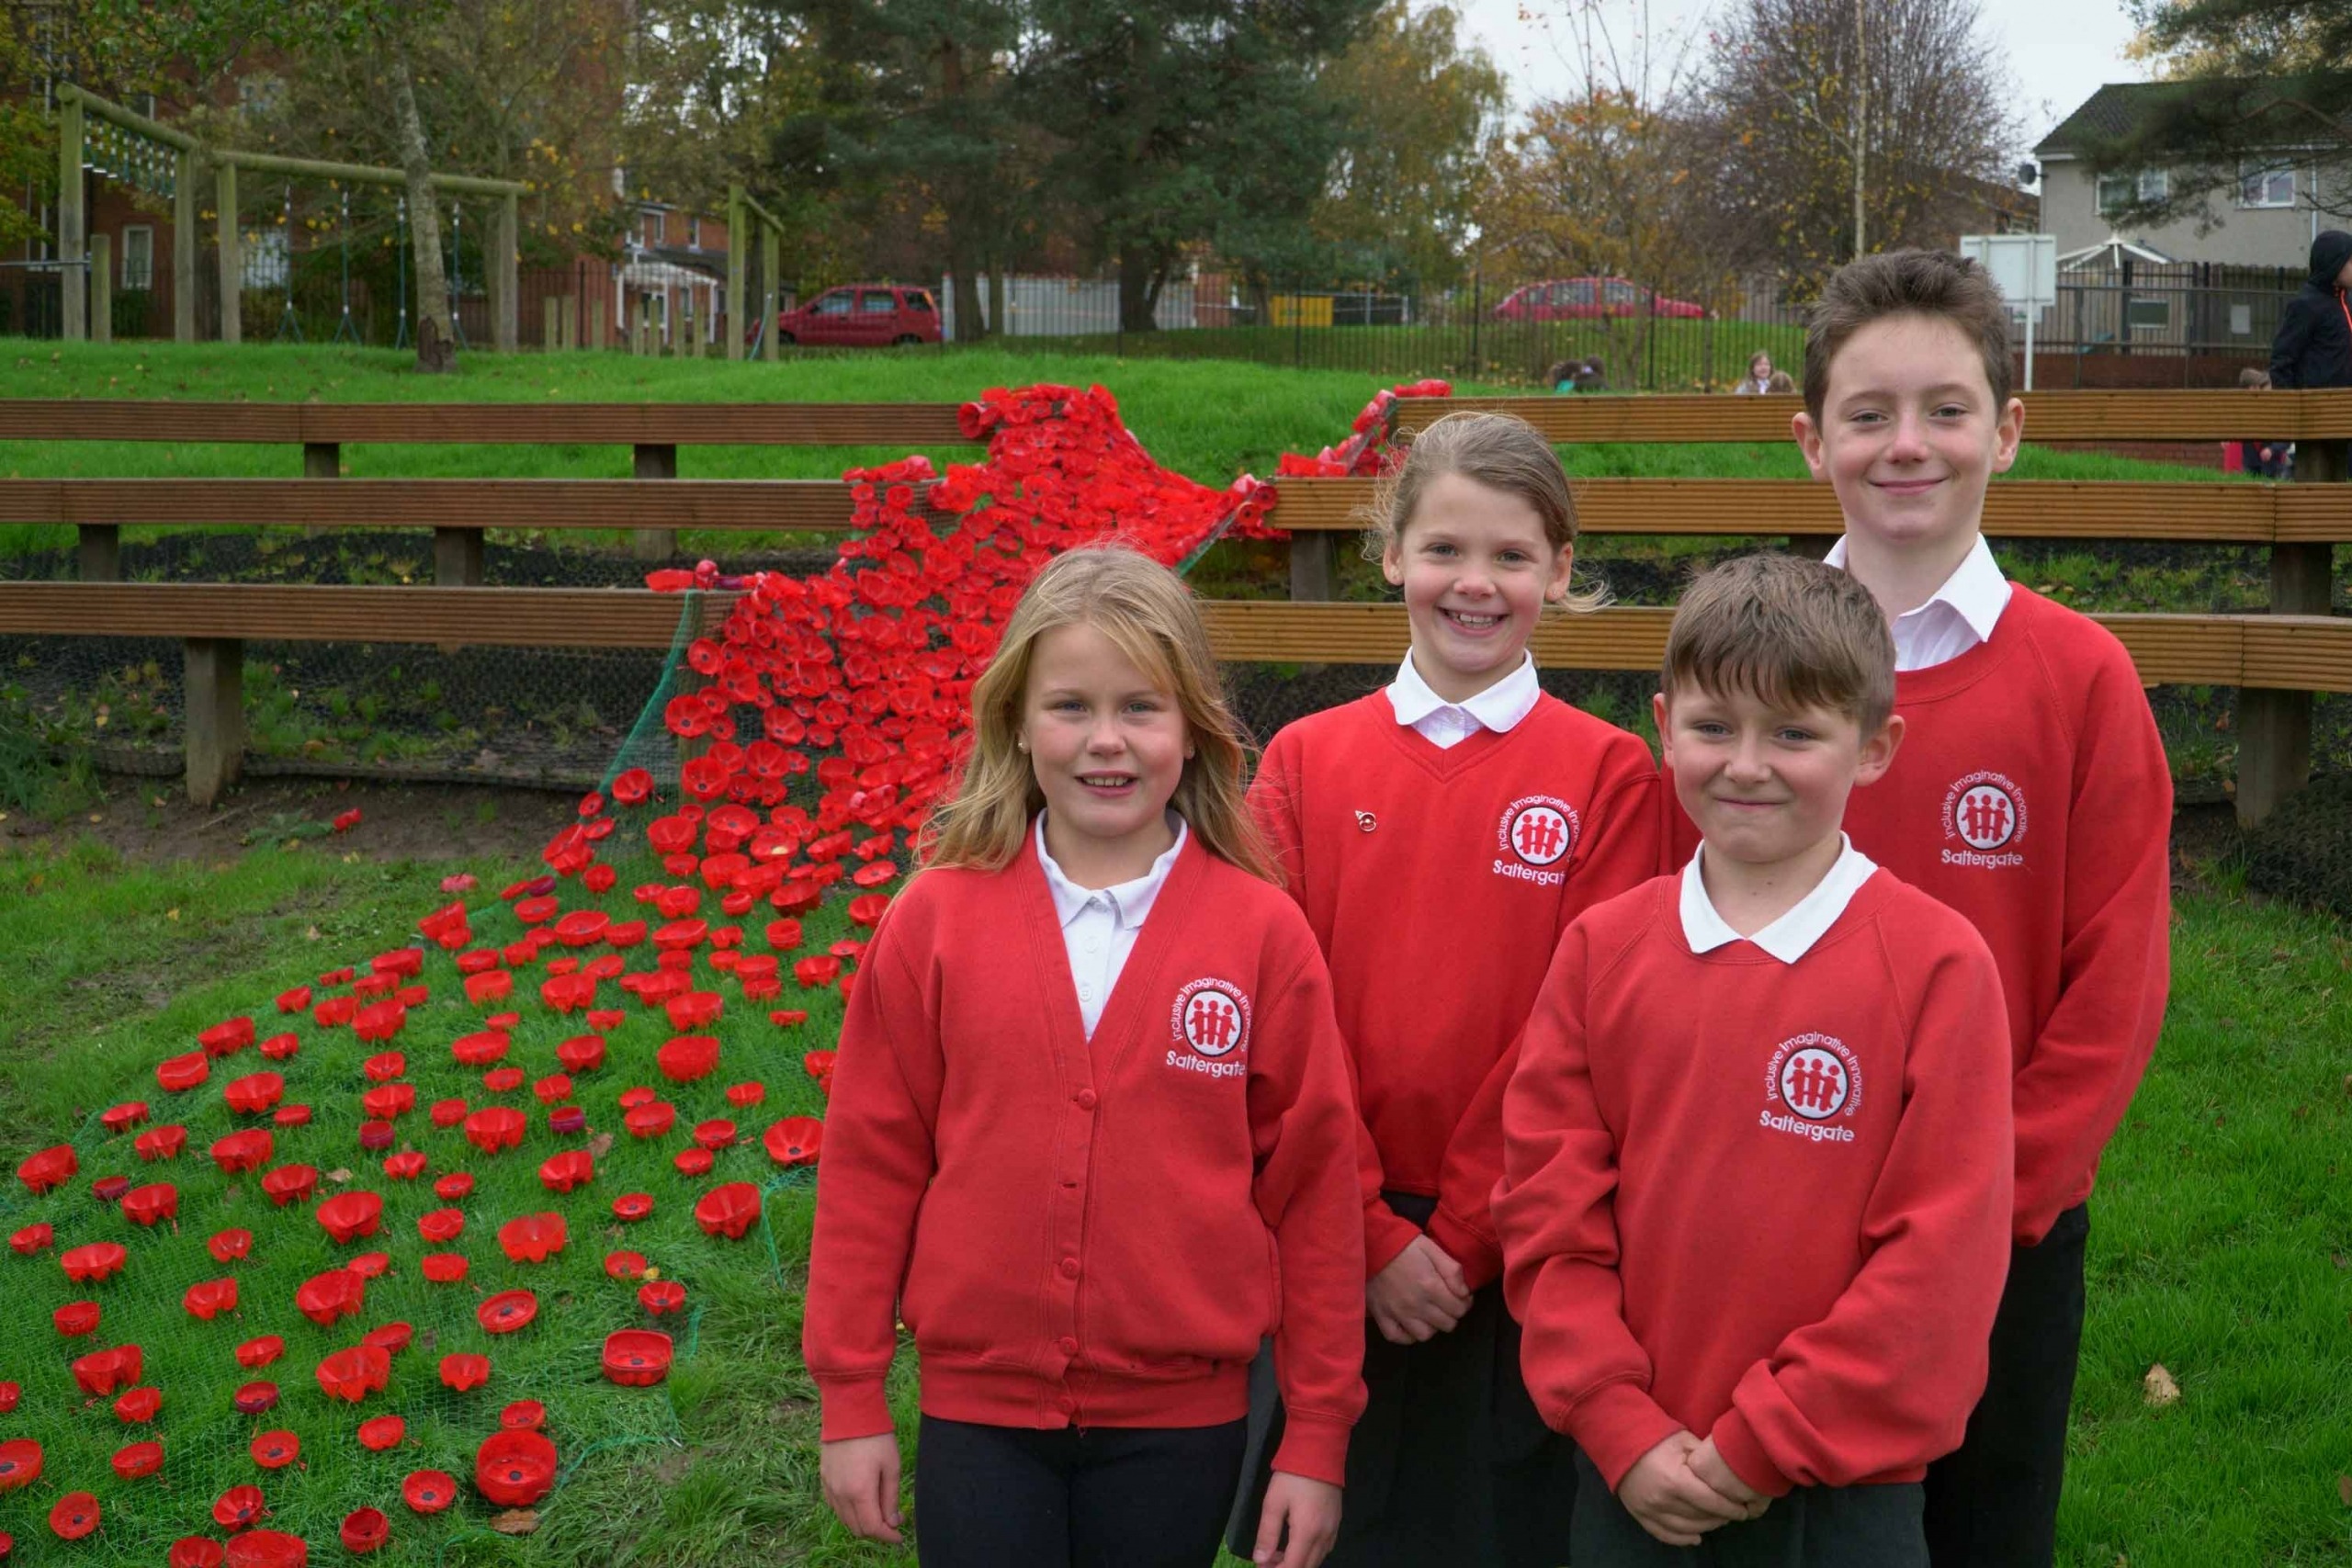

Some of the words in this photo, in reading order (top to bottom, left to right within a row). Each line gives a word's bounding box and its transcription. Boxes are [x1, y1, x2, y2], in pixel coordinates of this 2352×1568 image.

[1493, 859, 1566, 886] Saltergat
[1941, 849, 2023, 869] Saltergate
[1166, 1049, 1246, 1077] Saltergate
[1758, 1110, 1855, 1142] Saltergate
